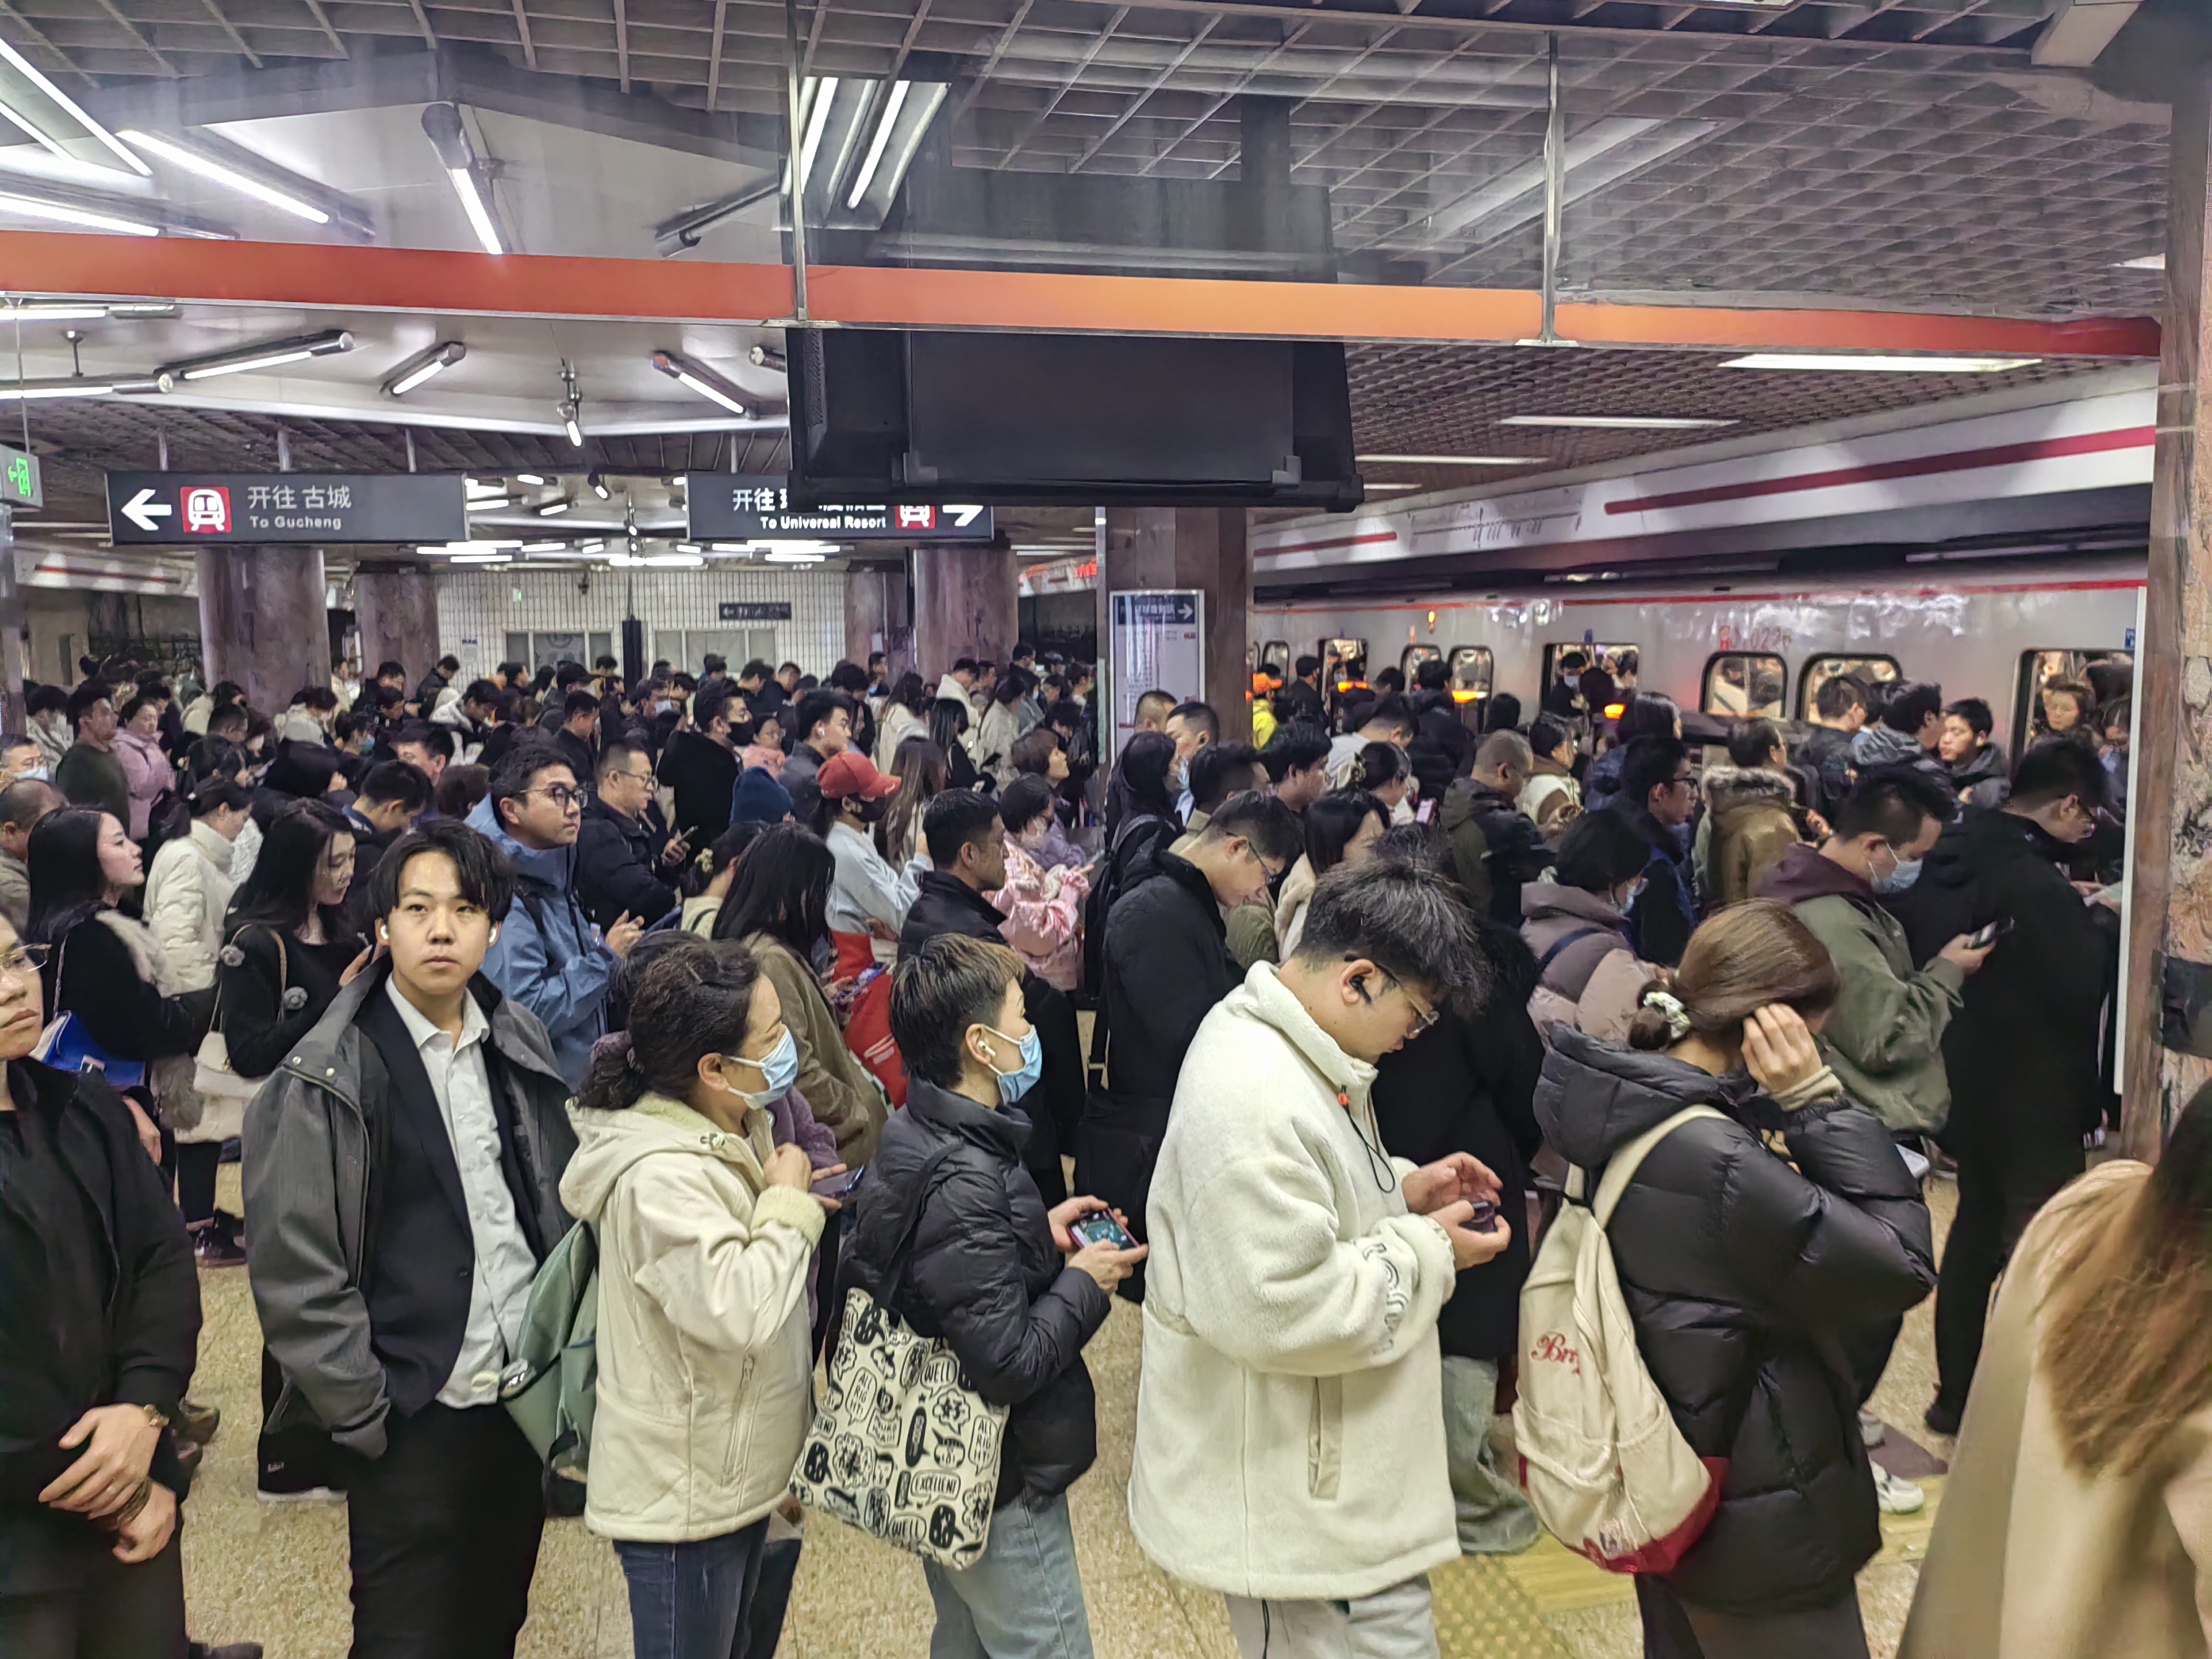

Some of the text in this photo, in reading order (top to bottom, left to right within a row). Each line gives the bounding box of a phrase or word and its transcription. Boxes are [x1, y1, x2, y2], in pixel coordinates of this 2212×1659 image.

[247, 484, 352, 510] 开往 古城
[732, 487, 775, 511] 开往
[249, 515, 342, 531] To Gucheng
[760, 515, 886, 529] To Universal Resort
[924, 1360, 950, 1384] WELL
